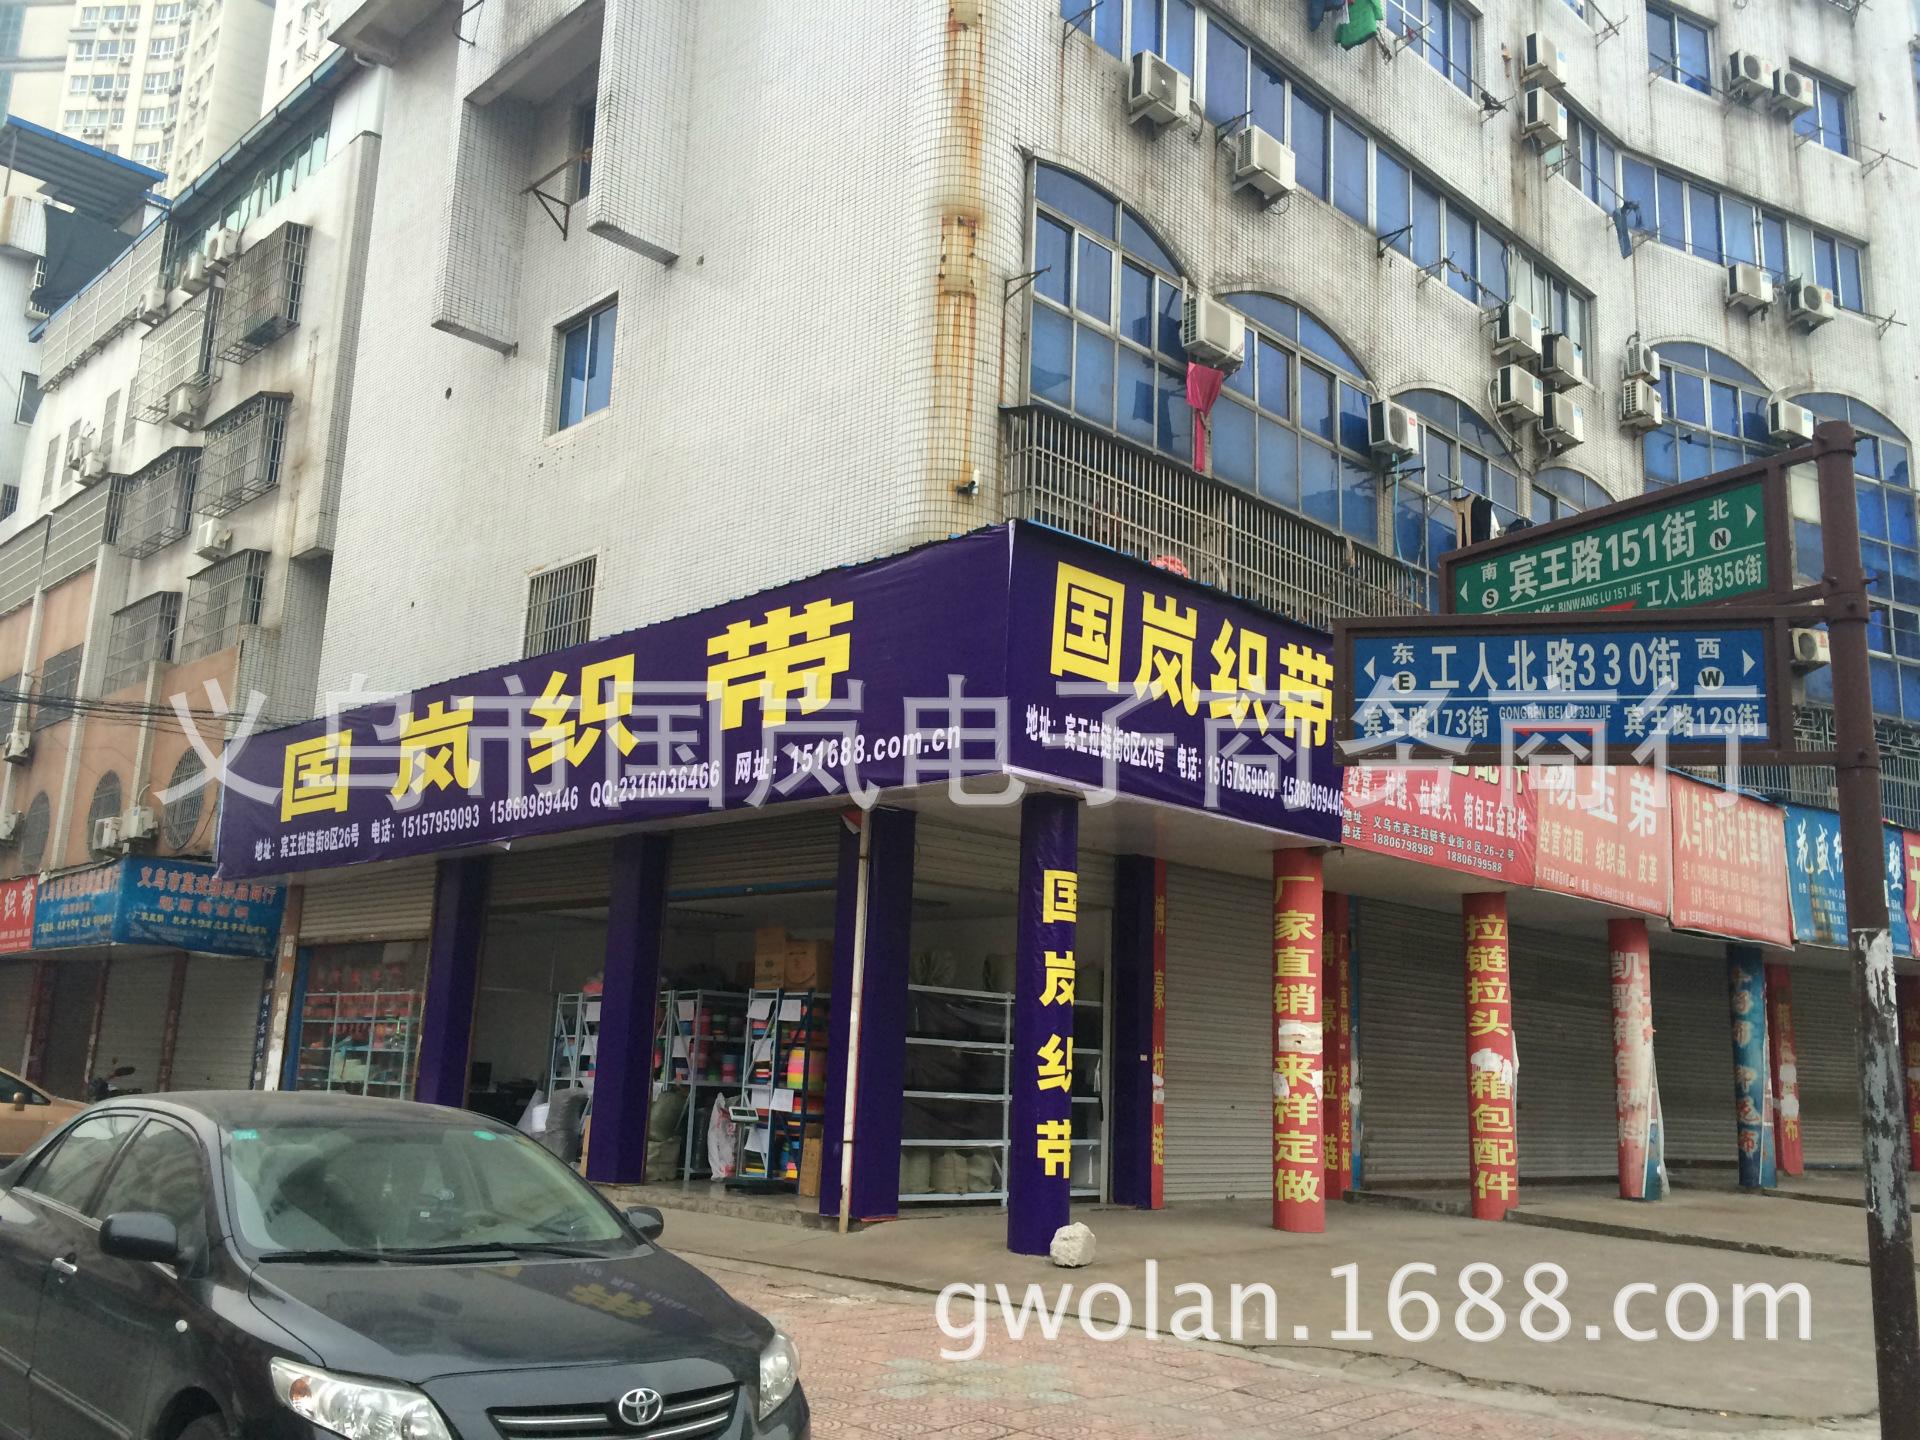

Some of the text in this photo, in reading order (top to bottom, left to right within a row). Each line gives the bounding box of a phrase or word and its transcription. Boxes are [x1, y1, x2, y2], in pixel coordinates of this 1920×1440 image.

[1707, 498, 1730, 522] 北
[1480, 561, 1498, 584] 南
[1509, 510, 1697, 602] 宾王路151街
[1558, 593, 1599, 613] BINWANG
[1600, 590, 1612, 604] LU
[1613, 586, 1628, 600] 151
[1629, 582, 1643, 597] JIE
[1647, 553, 1762, 608] 工人北路356街
[1050, 561, 1335, 748] 国岚织带
[1391, 643, 1415, 665] 东
[1429, 637, 1681, 692] 工人北路330街
[1695, 637, 1722, 660] 西
[1700, 669, 1723, 690] W
[280, 598, 854, 823] 国岚织带
[1363, 705, 1490, 739] 宾王路173街
[1499, 705, 1546, 720] GONGREN
[1579, 705, 1595, 719] 330
[1597, 704, 1612, 718] JIE
[1623, 703, 1761, 739] 宾王路129街
[489, 785, 579, 824] 15868969446
[590, 760, 720, 807] QQ:2316036466
[1282, 775, 1344, 818] 15868969446
[1446, 849, 1503, 873] 18806799588
[1465, 913, 1510, 1038] 拉链拉头
[1273, 876, 1321, 1204] 厂家直销 来样定做
